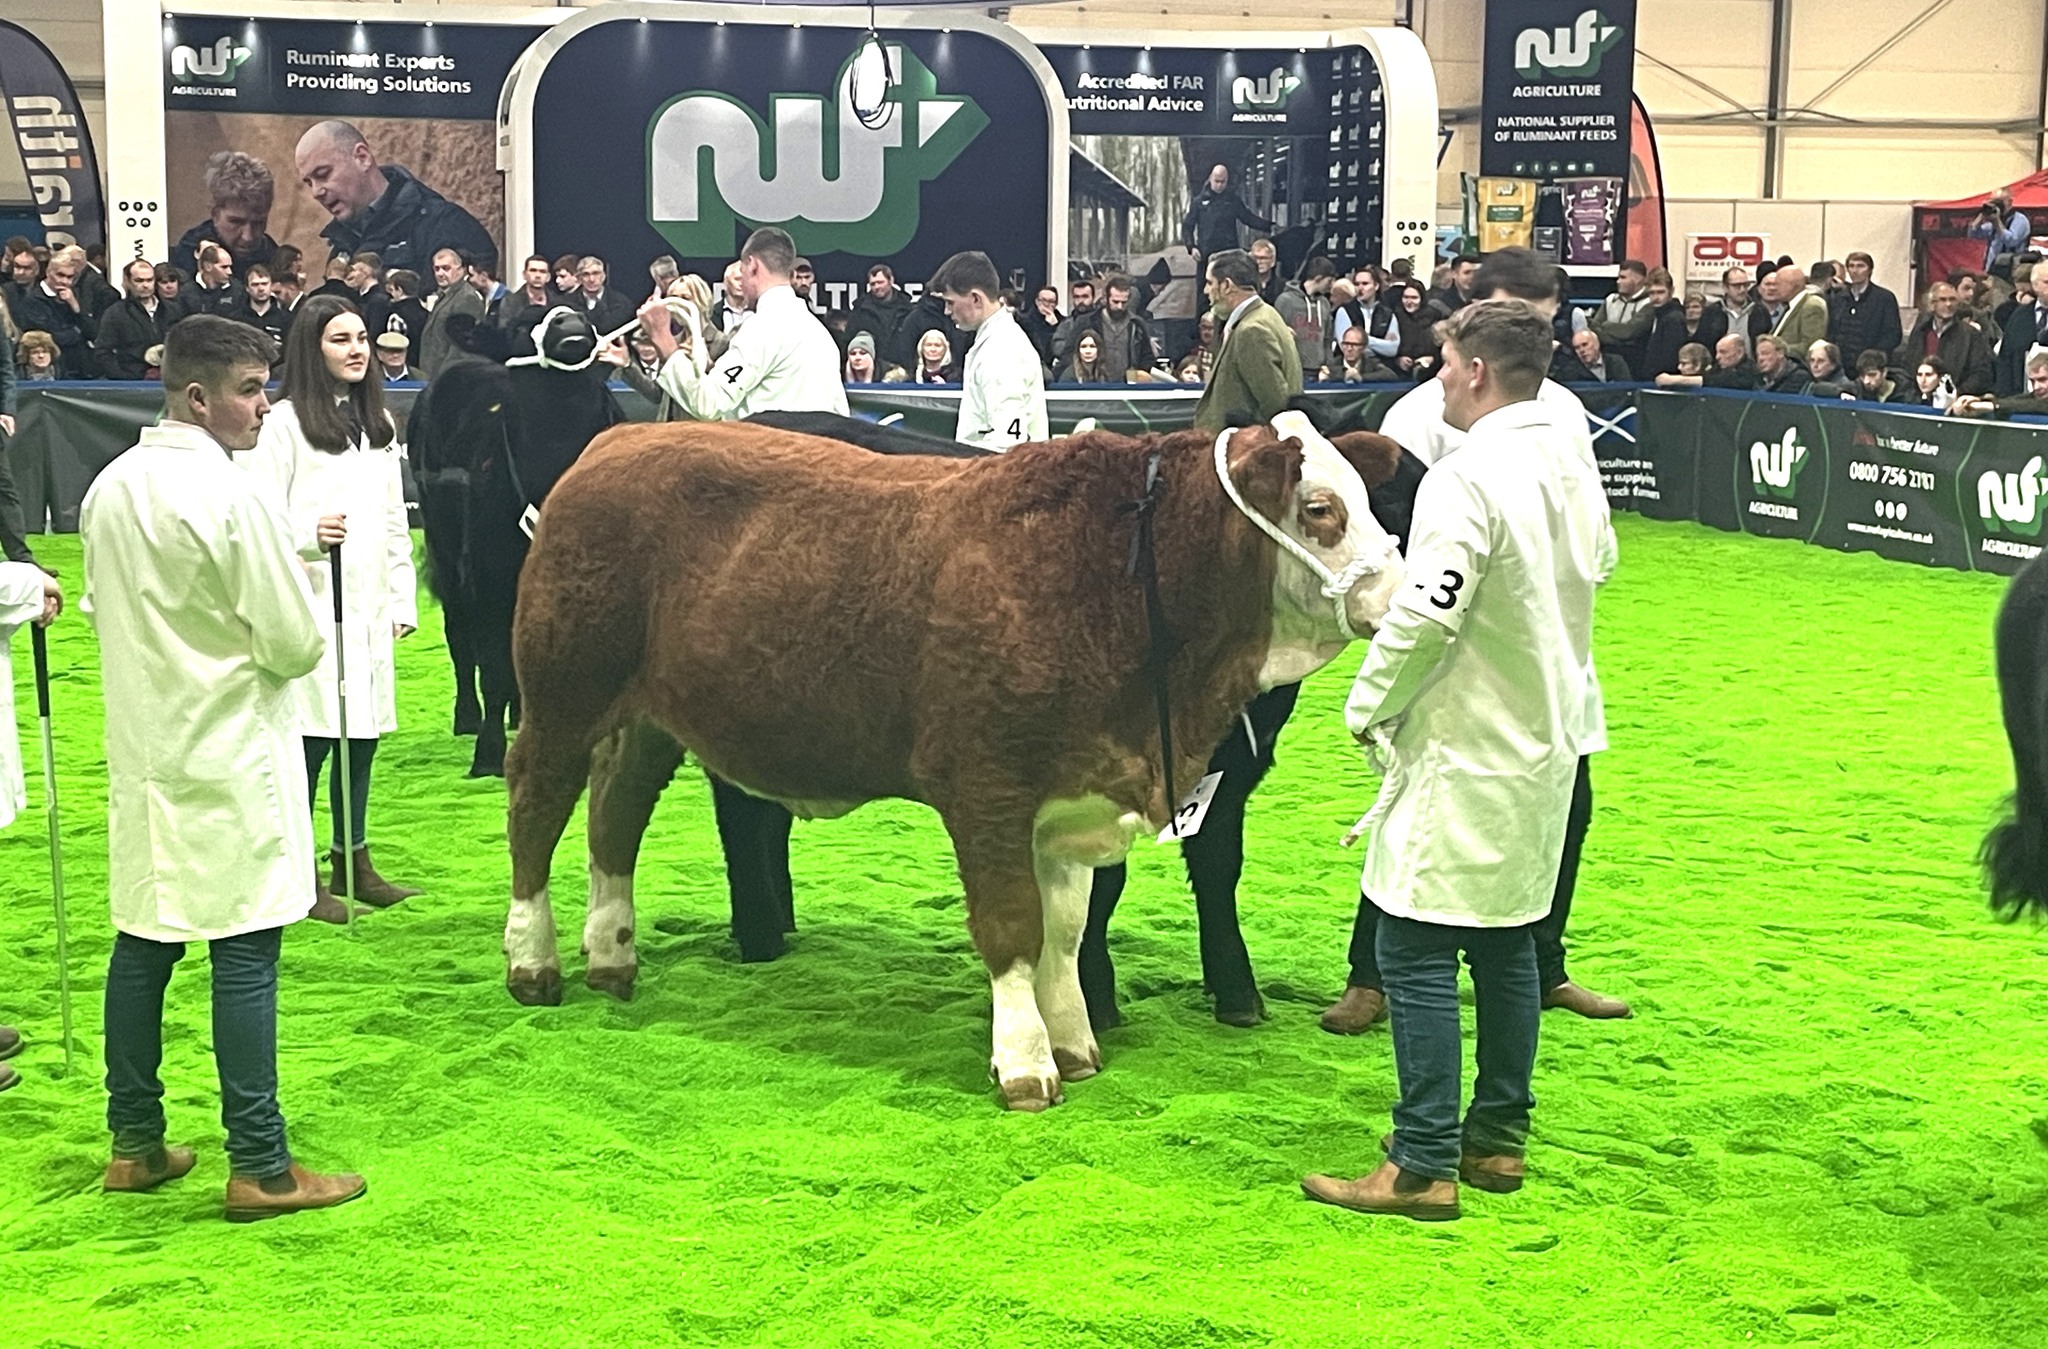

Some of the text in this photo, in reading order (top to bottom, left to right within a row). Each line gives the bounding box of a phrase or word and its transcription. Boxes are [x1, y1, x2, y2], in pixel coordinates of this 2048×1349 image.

[286, 50, 456, 72] Ruminant Experts
[286, 73, 472, 95] Providing Solutions
[1077, 73, 1205, 91] Accredited FAR
[1512, 84, 1602, 98] AGRICULTURE
[171, 85, 237, 98] AGRICULTURE
[1147, 96, 1204, 112] Advice
[1231, 113, 1287, 123] AGRICULTURE
[1497, 115, 1615, 127] NATIONAL SUPPLIER
[1494, 129, 1618, 142] OF RUMINANT FEEDS
[1693, 236, 1764, 267] ag
[724, 365, 744, 384] 4
[1006, 418, 1022, 440] 4
[1849, 461, 1879, 483] 0800
[1881, 465, 1907, 487] 756
[1429, 569, 1465, 611] 3
